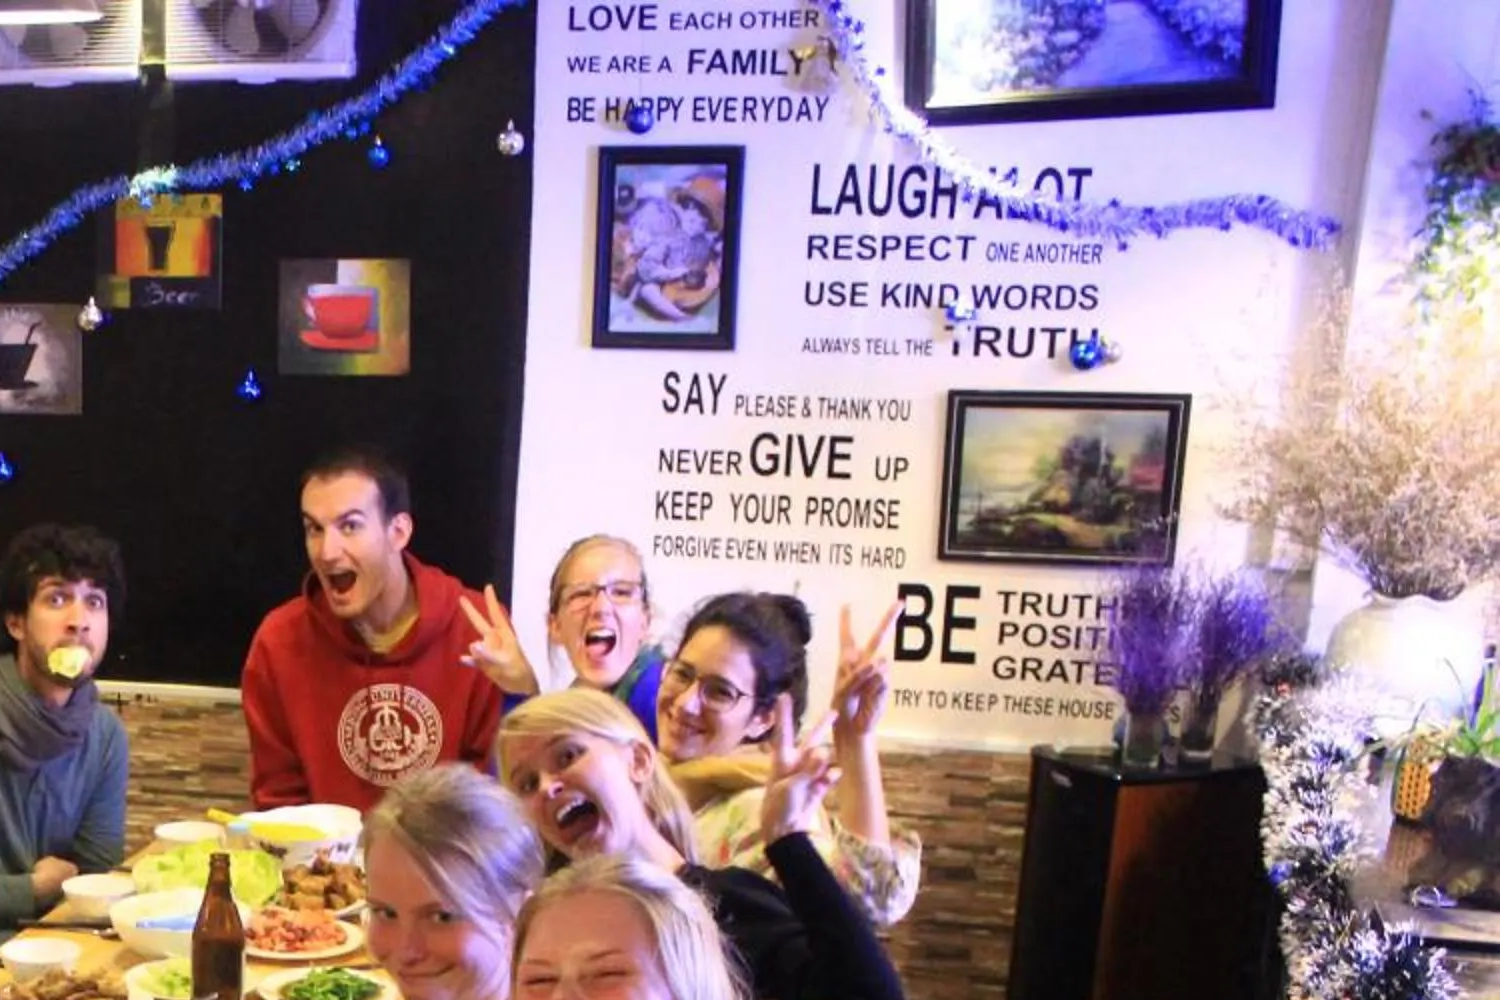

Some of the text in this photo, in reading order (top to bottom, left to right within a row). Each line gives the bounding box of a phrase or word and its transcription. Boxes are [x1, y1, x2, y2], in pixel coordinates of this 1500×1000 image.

[568, 5, 819, 31] LOVE EACH OTHER
[567, 48, 804, 75] WE ARE A FAMILY
[567, 96, 829, 122] BE HAPPY EVERYDAY
[810, 163, 959, 219] LAUGH
[807, 235, 1103, 264] RESPECT ONE ANOTHER
[804, 281, 1099, 310] USE KIND WORDS
[802, 337, 861, 355] ALWAYS
[866, 338, 900, 356] TELL
[905, 339, 933, 357] THE
[662, 371, 911, 421] SAY PLEASE & THANK YOU
[658, 432, 909, 481] NEVER GIVE UP
[655, 490, 900, 529] KEEP YOUR PROMSE
[653, 535, 906, 569] FORGIVE EVEN WHEN ITS HARD
[997, 591, 1118, 619] TRUTH
[894, 582, 981, 665] BE
[998, 622, 1116, 650] POSITI
[992, 656, 1117, 687] GRATE
[894, 689, 1115, 720] TRY TO KEEP THESE HOUSE
